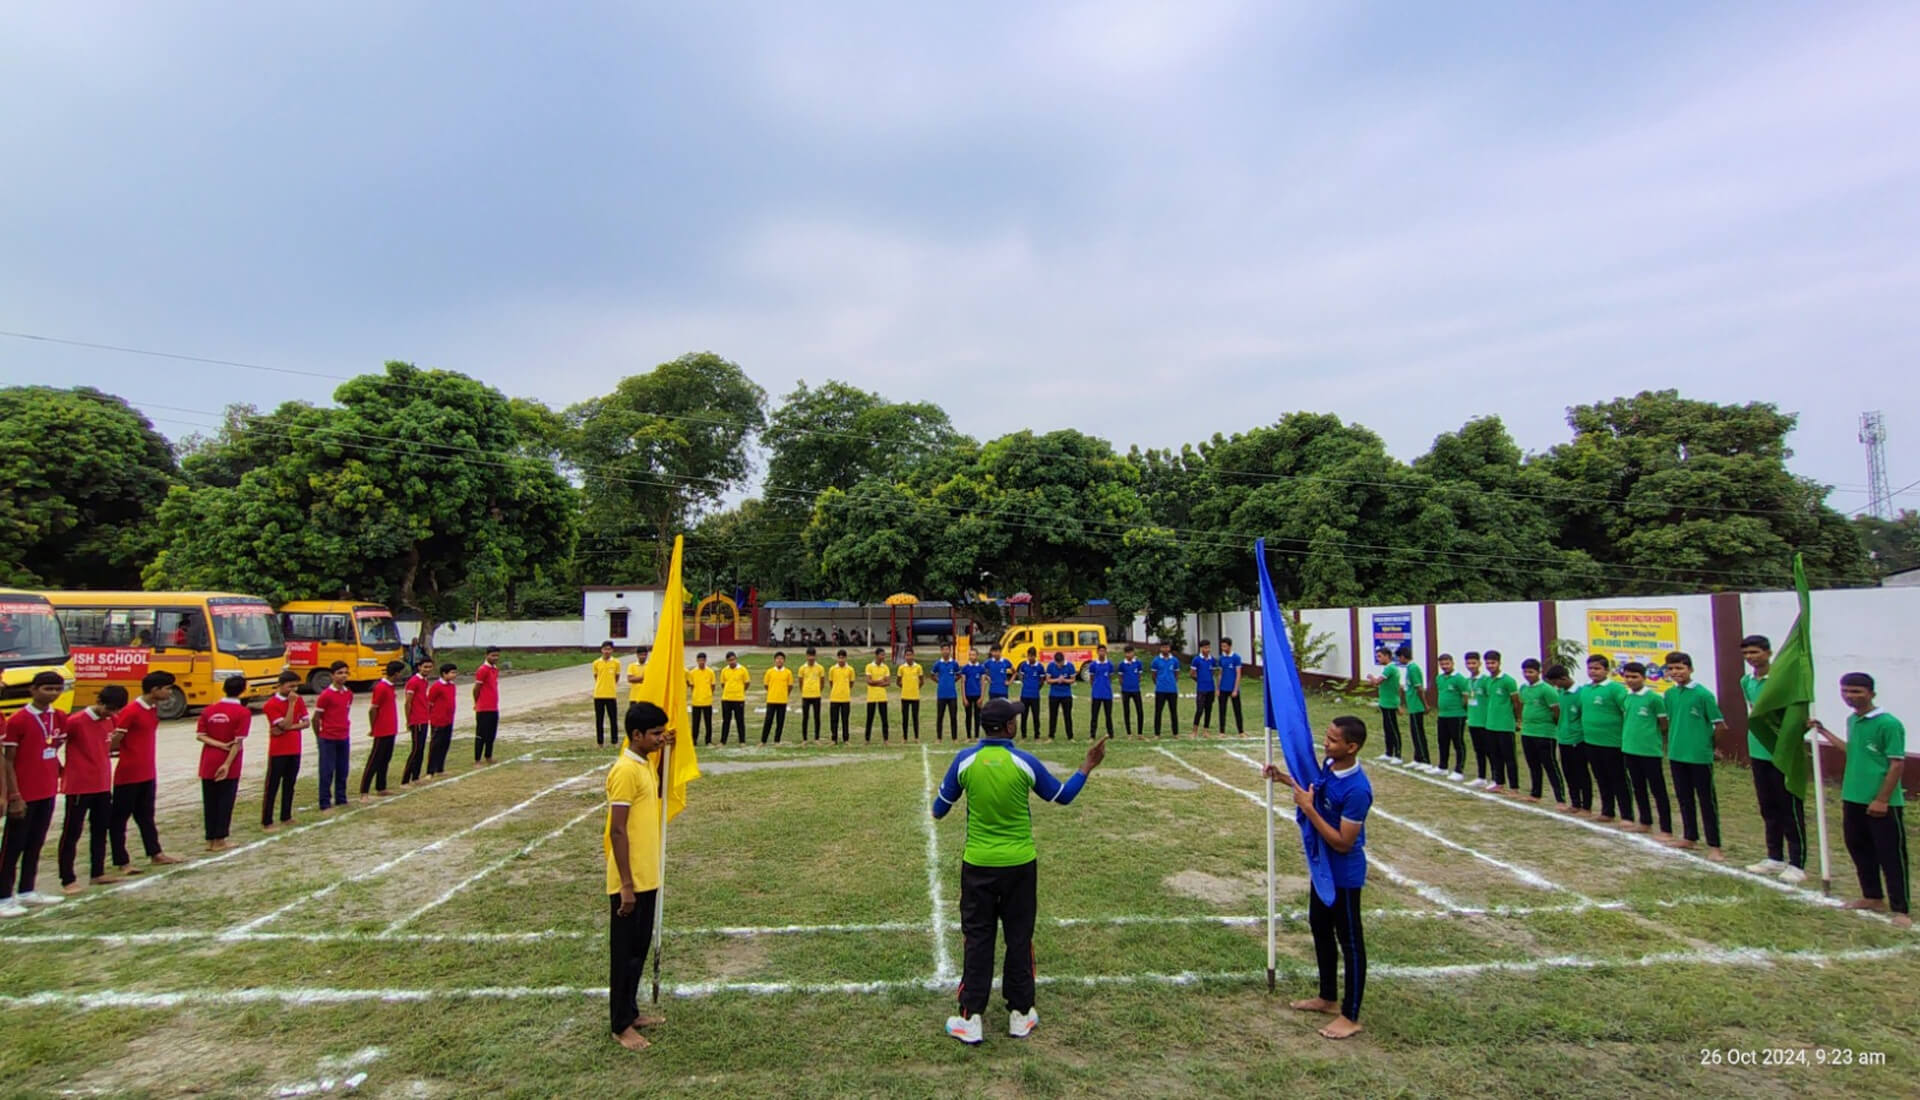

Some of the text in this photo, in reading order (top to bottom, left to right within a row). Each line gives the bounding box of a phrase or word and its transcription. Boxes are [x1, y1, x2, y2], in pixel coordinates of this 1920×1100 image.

[1604, 628, 1657, 638] Tagore House
[98, 653, 150, 665] SCHOOL
